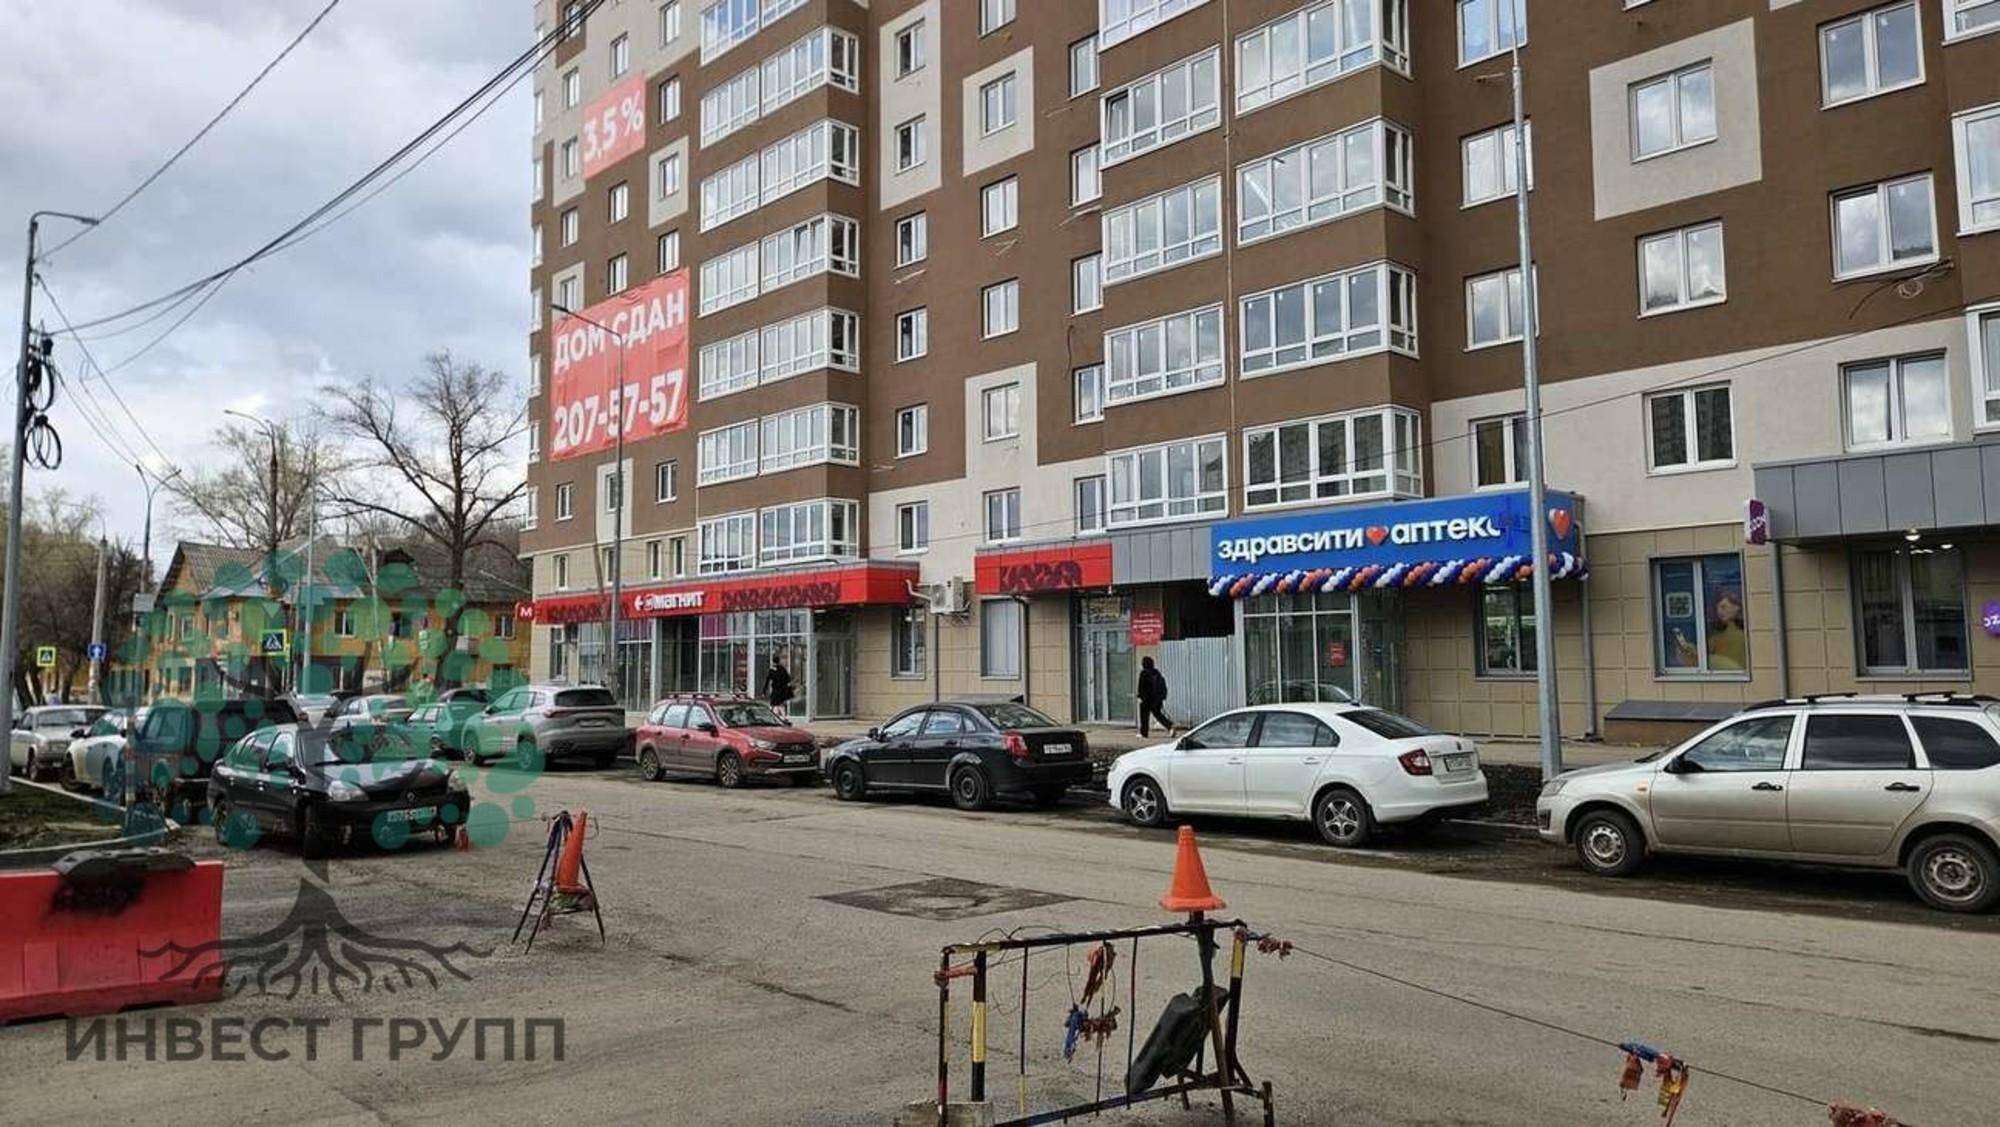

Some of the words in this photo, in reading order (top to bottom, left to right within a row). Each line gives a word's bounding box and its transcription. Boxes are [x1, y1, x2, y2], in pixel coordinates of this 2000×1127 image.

[554, 321, 606, 375] ДОМ
[612, 287, 685, 349] СДАН
[553, 368, 684, 453] 207-57-57
[1217, 527, 1364, 564] здравсити
